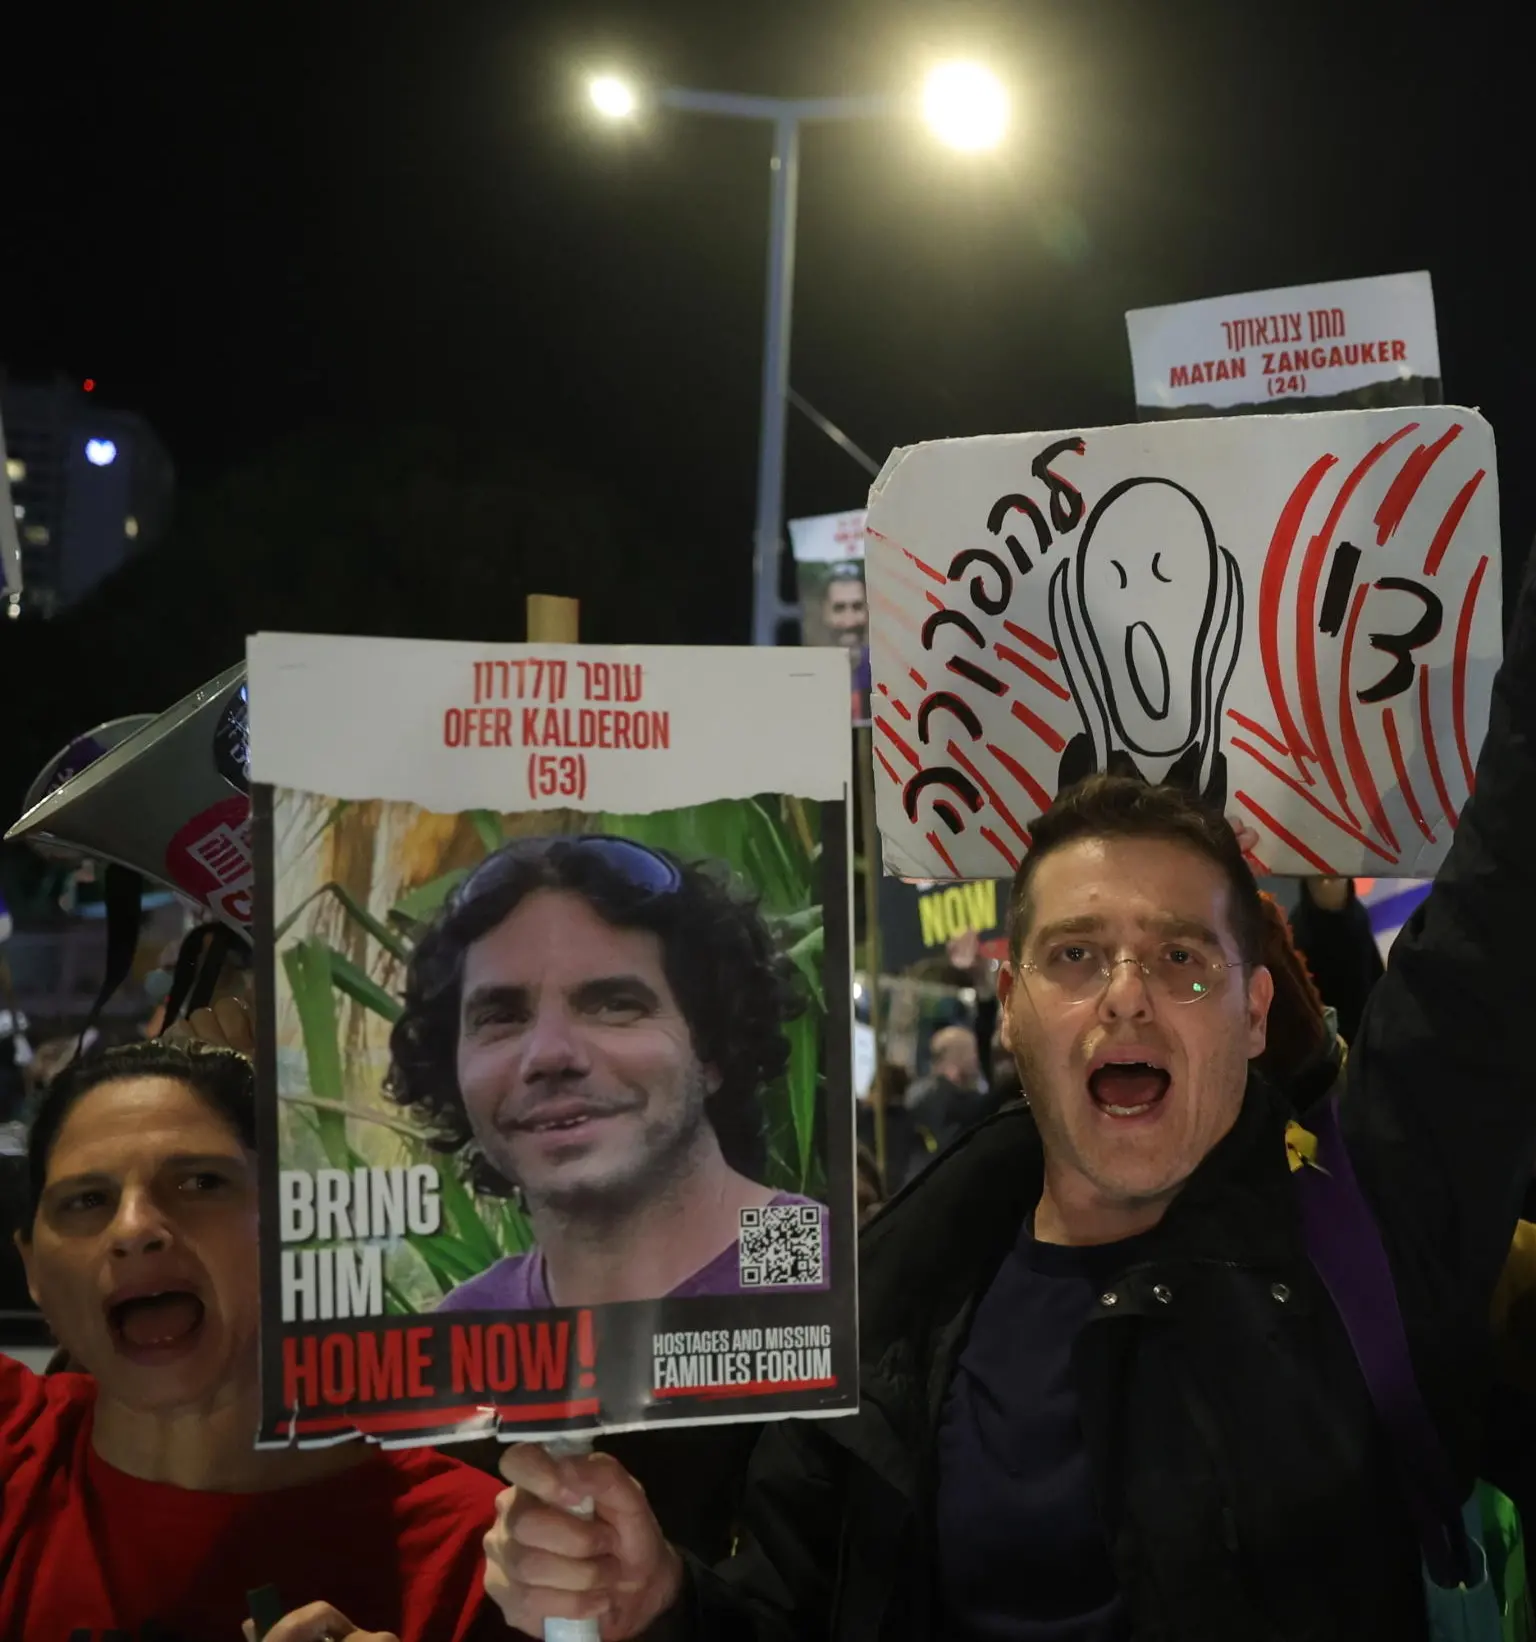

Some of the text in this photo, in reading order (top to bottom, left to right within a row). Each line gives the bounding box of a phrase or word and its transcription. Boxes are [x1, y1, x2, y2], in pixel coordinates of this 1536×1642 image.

[1308, 308, 1345, 340] מתן
[1170, 340, 1407, 388] MATAN ZANGAUKER
[1267, 376, 1306, 396] (24)
[473, 657, 643, 704] עופר קלדרון
[444, 708, 670, 749] OFER KALDERON
[528, 752, 586, 800] (53)
[918, 880, 997, 948] NOW
[280, 1164, 441, 1242] BRING
[281, 1245, 384, 1323] HIM
[282, 1310, 597, 1409] HOME NOW!
[653, 1325, 831, 1355] HOSTAGES AND MISSING
[654, 1348, 832, 1389] FAMILIES FORUM
